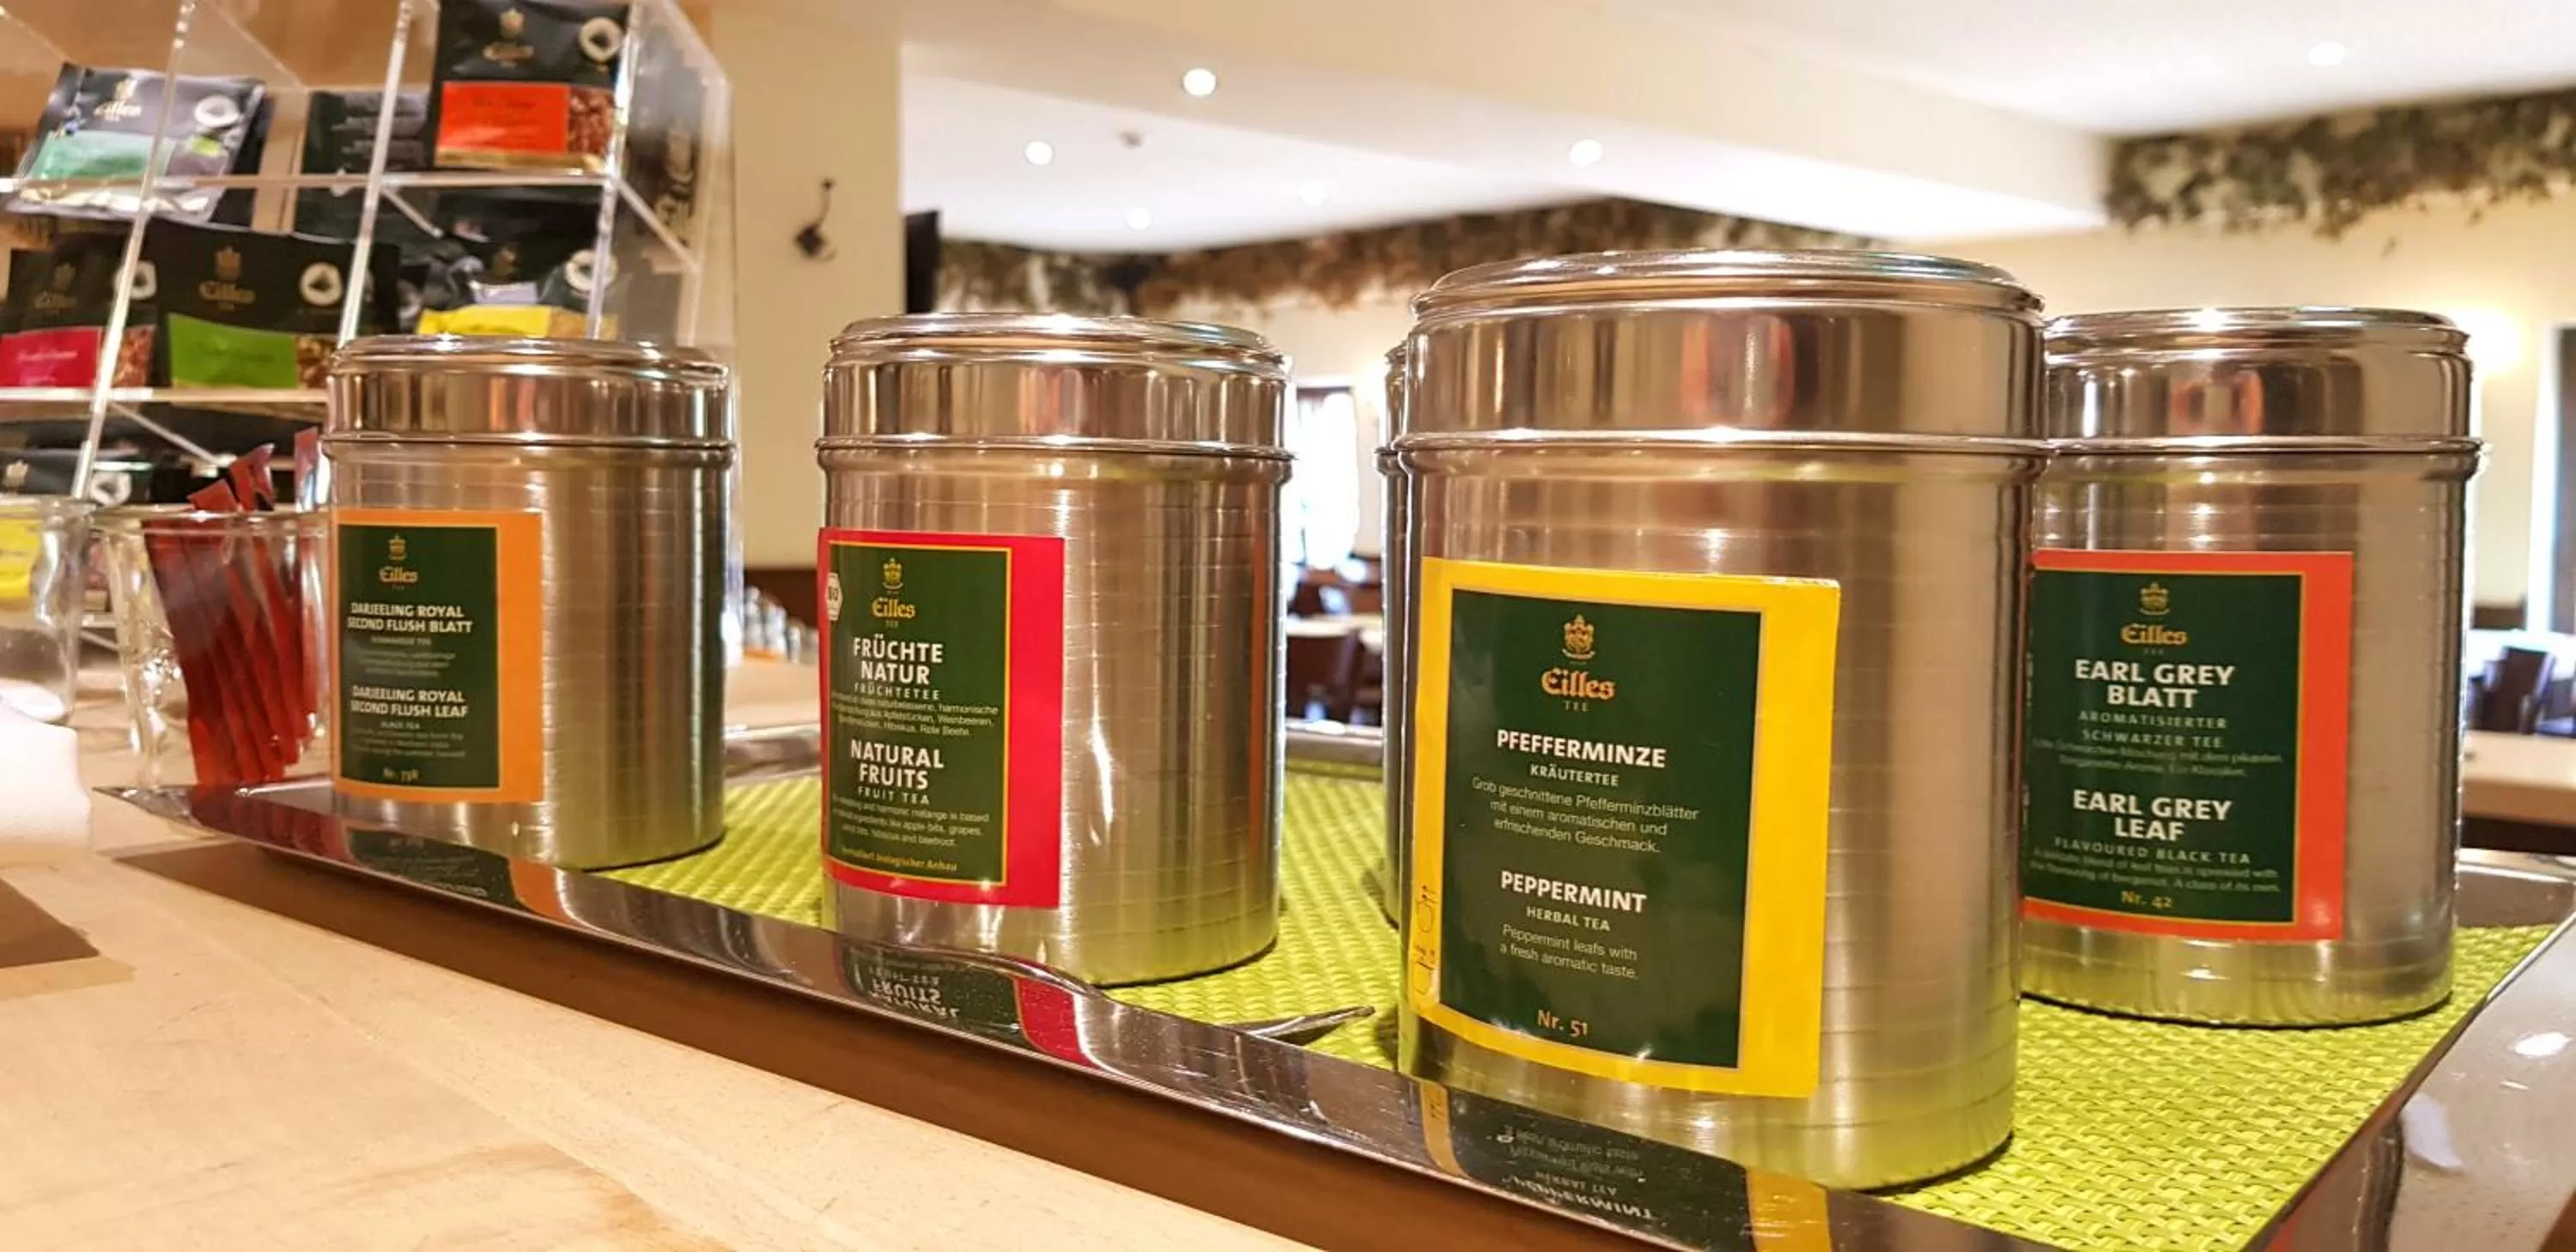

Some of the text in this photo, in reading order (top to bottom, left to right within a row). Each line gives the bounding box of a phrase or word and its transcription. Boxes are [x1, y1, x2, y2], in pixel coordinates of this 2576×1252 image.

[379, 566, 419, 583] Eilles
[351, 602, 465, 617] DARJEELING ROYAL
[872, 597, 915, 618] Eilles
[347, 617, 473, 633] SECOND FLUSH BLATT
[2120, 623, 2188, 646] Eilles
[853, 634, 944, 663] FRÜCHTE
[860, 660, 931, 685] NATUR
[1541, 667, 1616, 700] Eilles
[2075, 659, 2236, 686] EARL GREY
[352, 684, 465, 702] DARJEELING ROYAL
[854, 682, 940, 701] FRÜCHTETEE
[2106, 684, 2198, 708] BLATT
[350, 700, 468, 718] SECOND FLUSH LEAF
[1564, 701, 1588, 712] TEE
[2078, 710, 2227, 730] AROMATISIERTER
[1497, 728, 1667, 768] PFEFFERMINZE
[2081, 728, 2185, 748] SCHWARZER
[2191, 736, 2224, 749] TEE
[851, 739, 944, 769] NATURAL
[860, 763, 928, 789] FRUITS
[1529, 764, 1620, 787] KRÄUTERTEE
[858, 786, 895, 802] FRUIT
[902, 792, 930, 805] TEA
[1472, 776, 1700, 821] Grob geschnittene Pfefferminzblätter
[2073, 789, 2233, 821] EARL GREY
[1490, 800, 1668, 836] mit einem aromatischen und
[2114, 817, 2186, 842] LEAF
[1493, 817, 1661, 853] erfrischenden Geschmack.
[2055, 836, 2148, 858] FLAVOURED
[2156, 848, 2211, 862] BLACK
[2218, 852, 2251, 864] TEA
[1500, 869, 1648, 913] PEPPERMINT
[2121, 890, 2172, 909] Nr. 42
[1526, 906, 1611, 932] HERBAL TEA
[1503, 923, 1638, 961] Peppermint leafs with
[1499, 942, 1639, 979] a fresh aromatic taste.
[1537, 1009, 1589, 1038] Nr. 51
